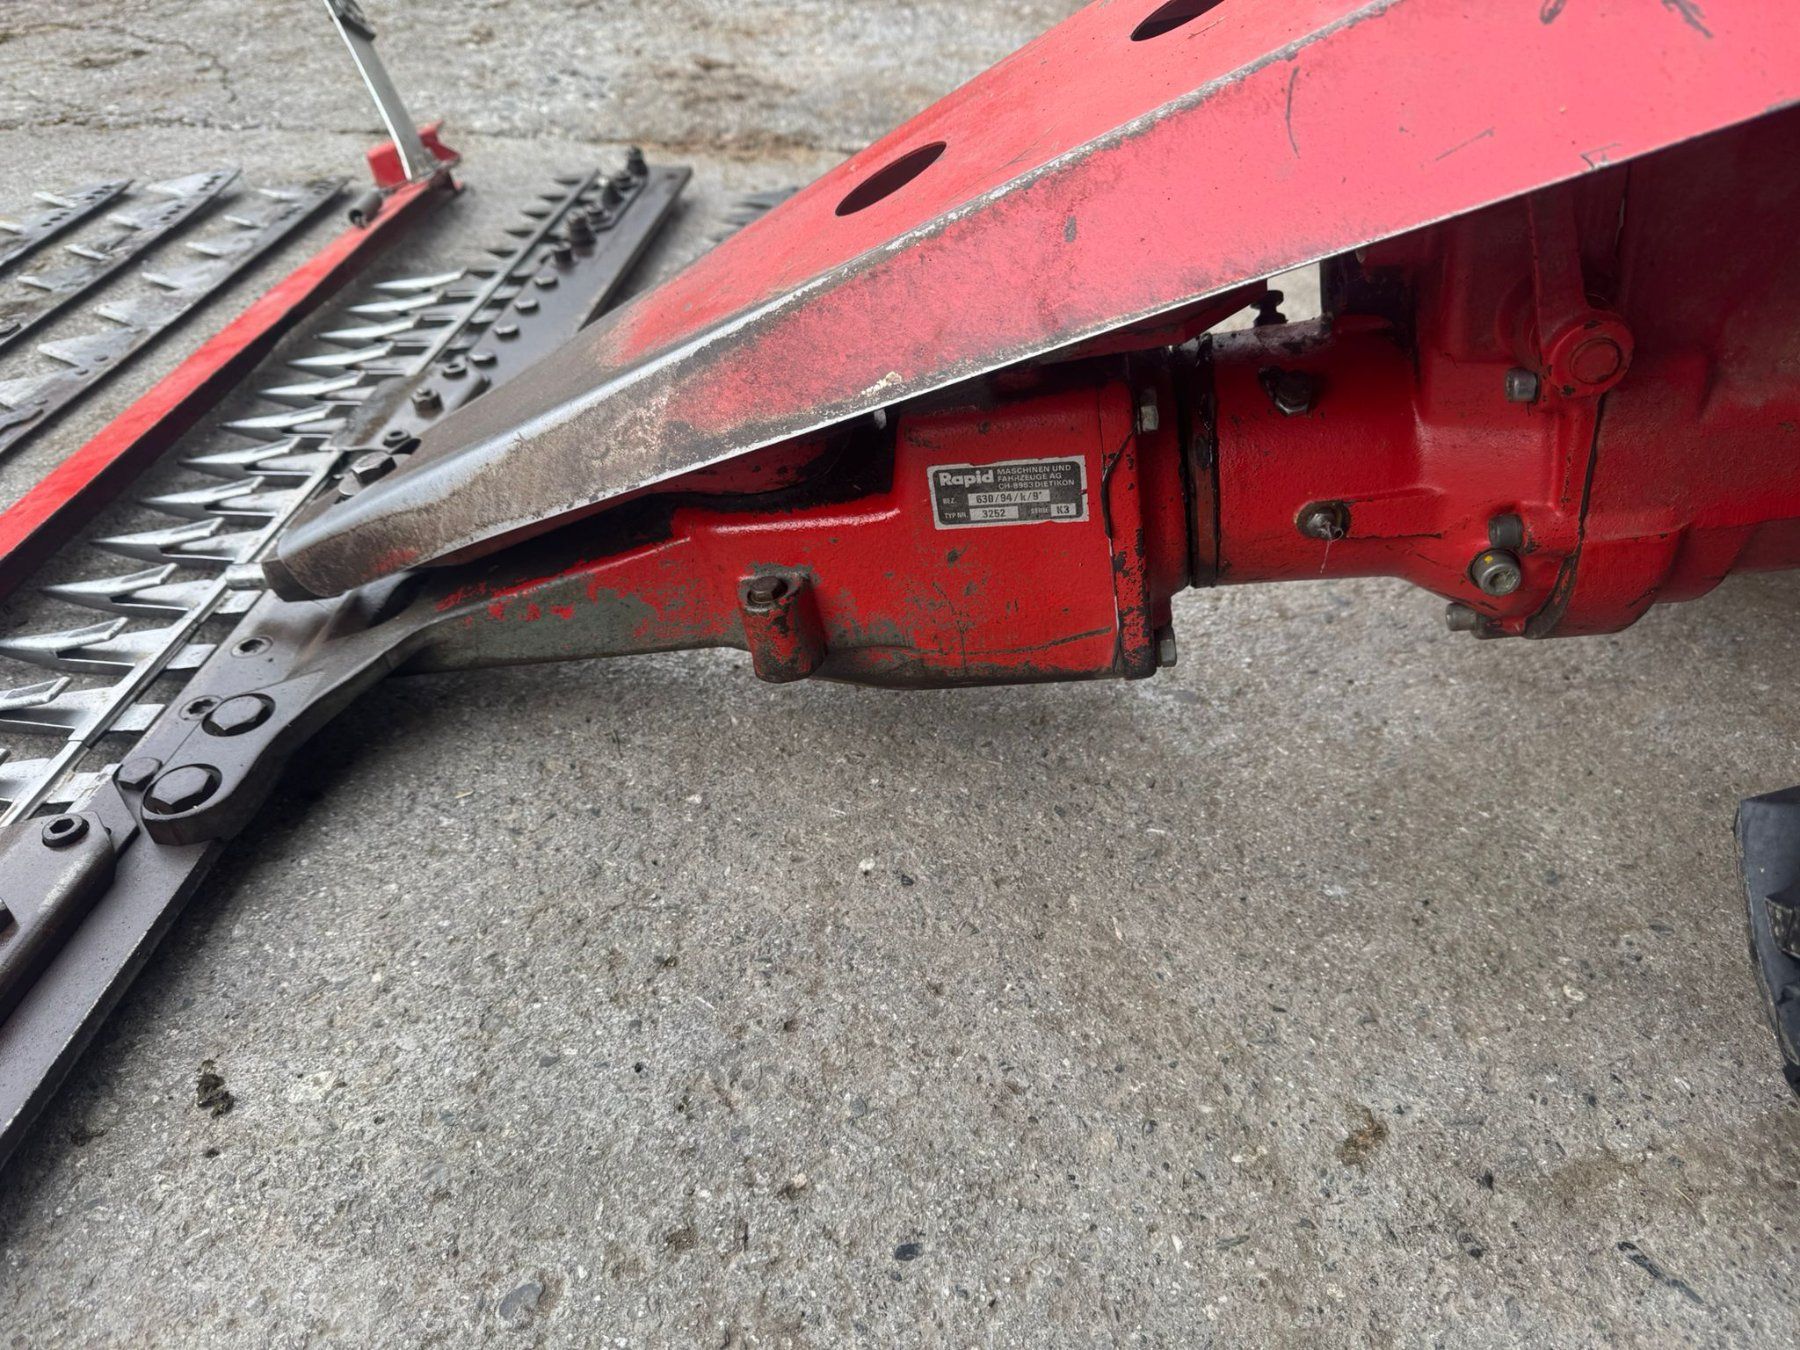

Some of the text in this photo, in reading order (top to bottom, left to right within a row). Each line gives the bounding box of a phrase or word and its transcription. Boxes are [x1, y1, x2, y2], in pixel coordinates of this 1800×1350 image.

[997, 464, 1072, 475] MASCHINEN UND
[939, 470, 994, 488] Rapid
[997, 472, 1062, 483] FAHRZEUGE AG
[1034, 480, 1075, 488] DIETIKON
[982, 508, 1006, 519] 3252
[1056, 505, 1070, 515] K3
